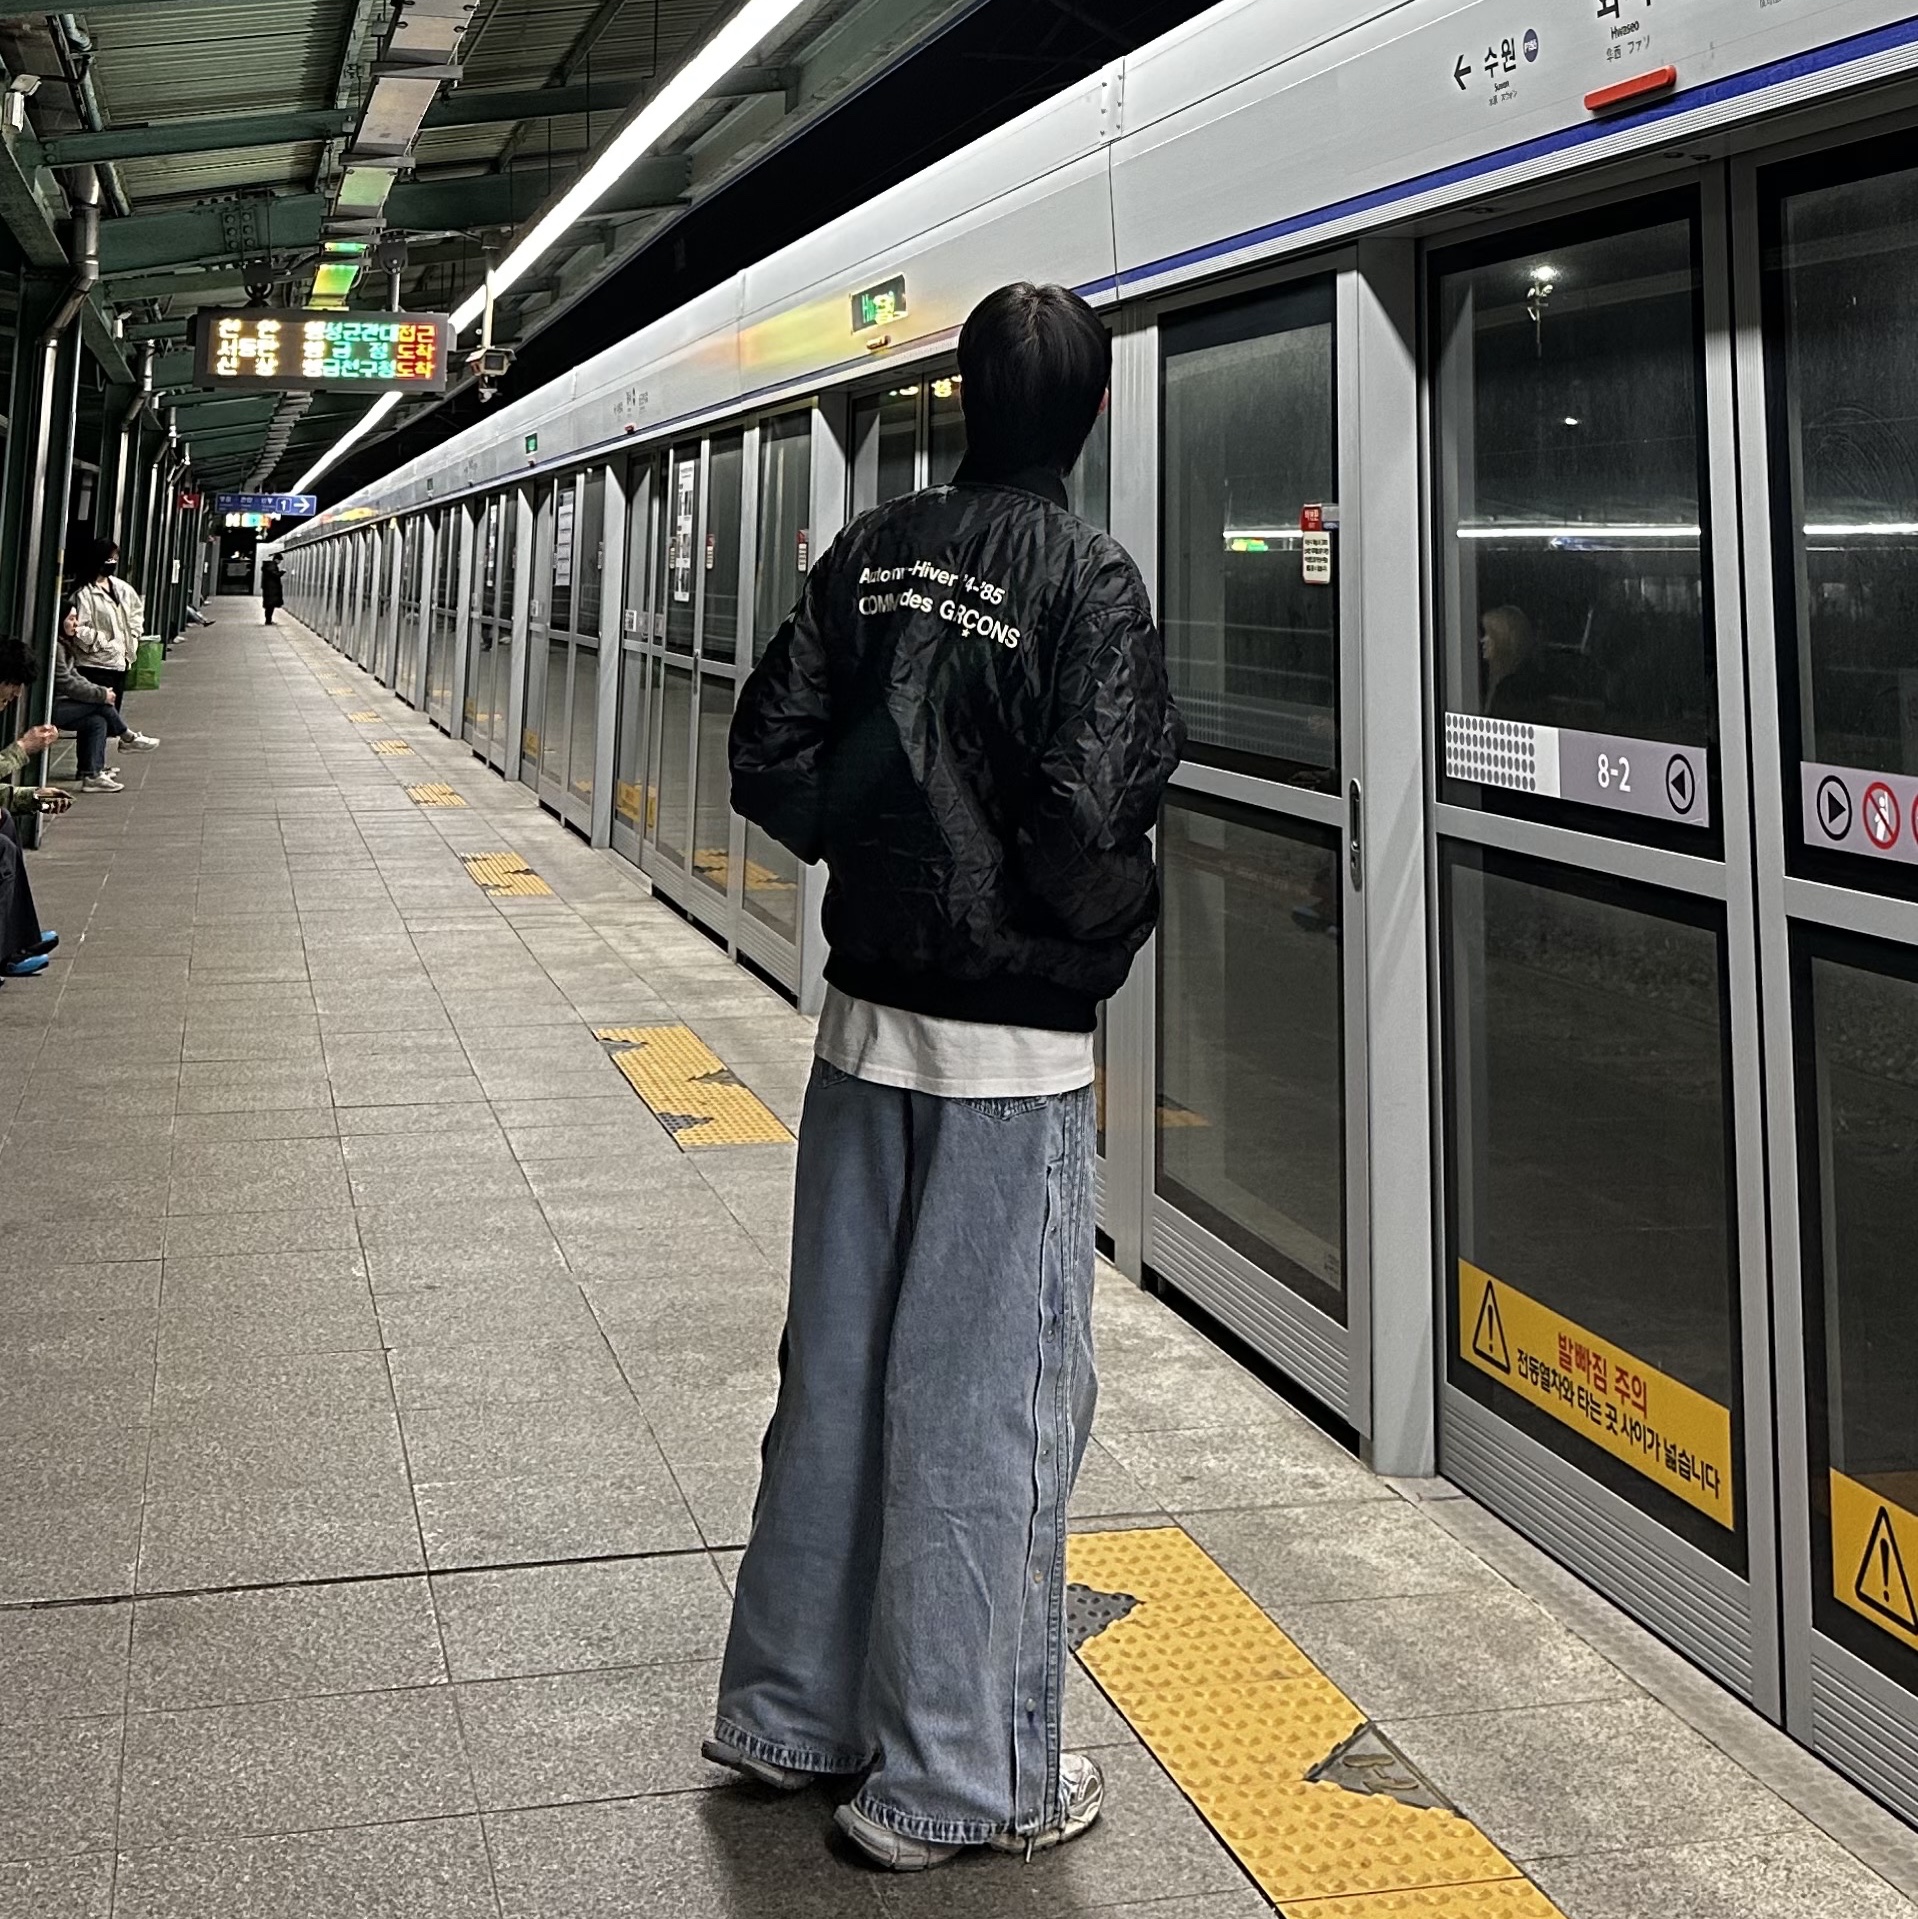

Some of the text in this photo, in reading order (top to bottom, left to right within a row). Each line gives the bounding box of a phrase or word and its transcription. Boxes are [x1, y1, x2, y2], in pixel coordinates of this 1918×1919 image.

[1484, 38, 1516, 78] 수원
[396, 361, 436, 379] 도착
[397, 343, 436, 360] 도착
[899, 588, 934, 613] des
[1598, 753, 1631, 792] 8-2
[1558, 1332, 1647, 1420] 발빠짐 주의
[1517, 1348, 1721, 1499] 전동열차와 타는 곳 사이가 넓습니다
